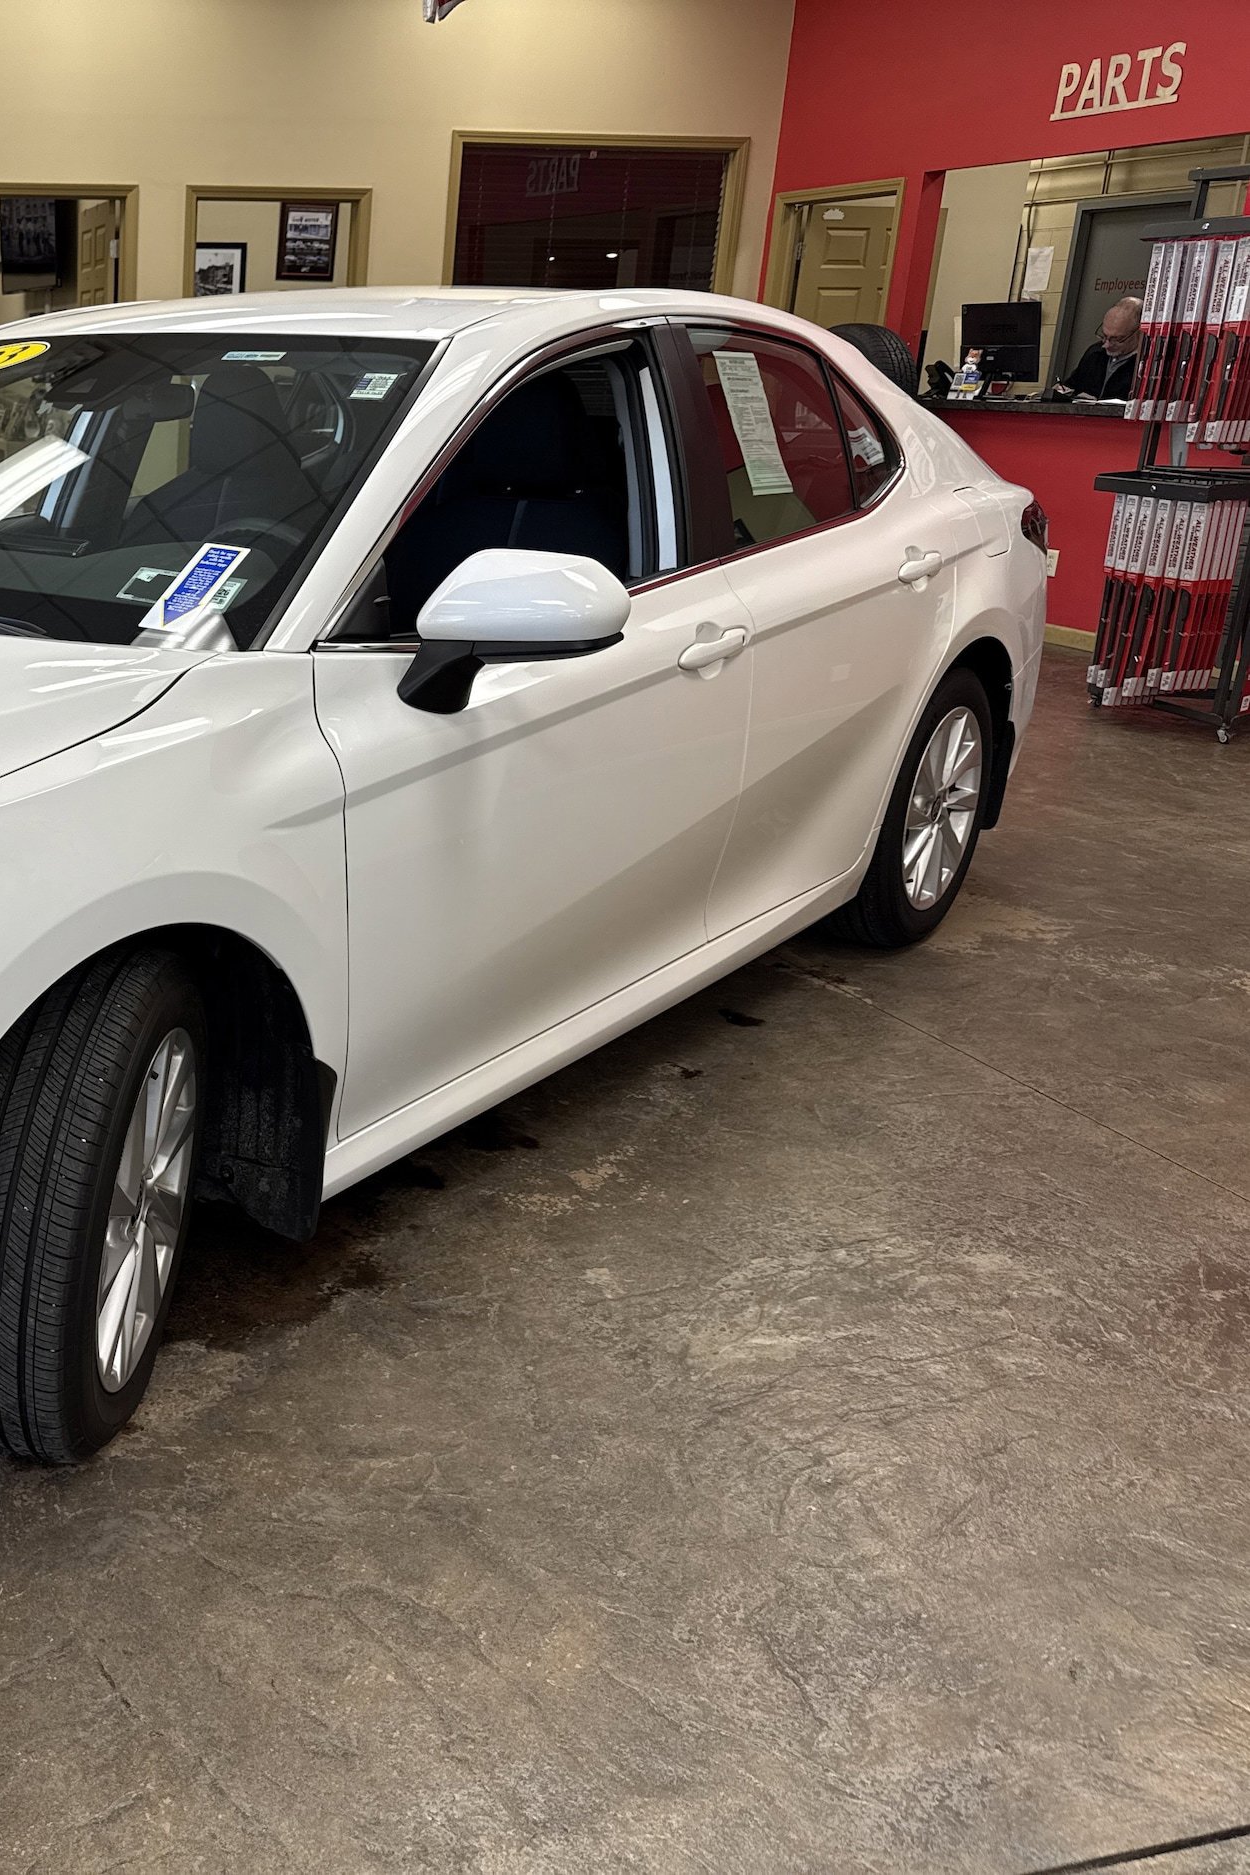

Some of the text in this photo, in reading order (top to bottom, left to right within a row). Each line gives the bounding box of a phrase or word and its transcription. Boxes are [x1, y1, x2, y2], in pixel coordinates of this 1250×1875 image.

[1049, 41, 1187, 122] PARTS
[1095, 277, 1146, 294] Employees
[1216, 259, 1230, 313] ALL-WEATHER
[1133, 513, 1148, 563] ALL-WEATHER
[1151, 517, 1165, 567] ALL-WEATHER
[1171, 518, 1185, 569] ALL-WEATHER
[1188, 519, 1202, 571] ALL-WEATHER
